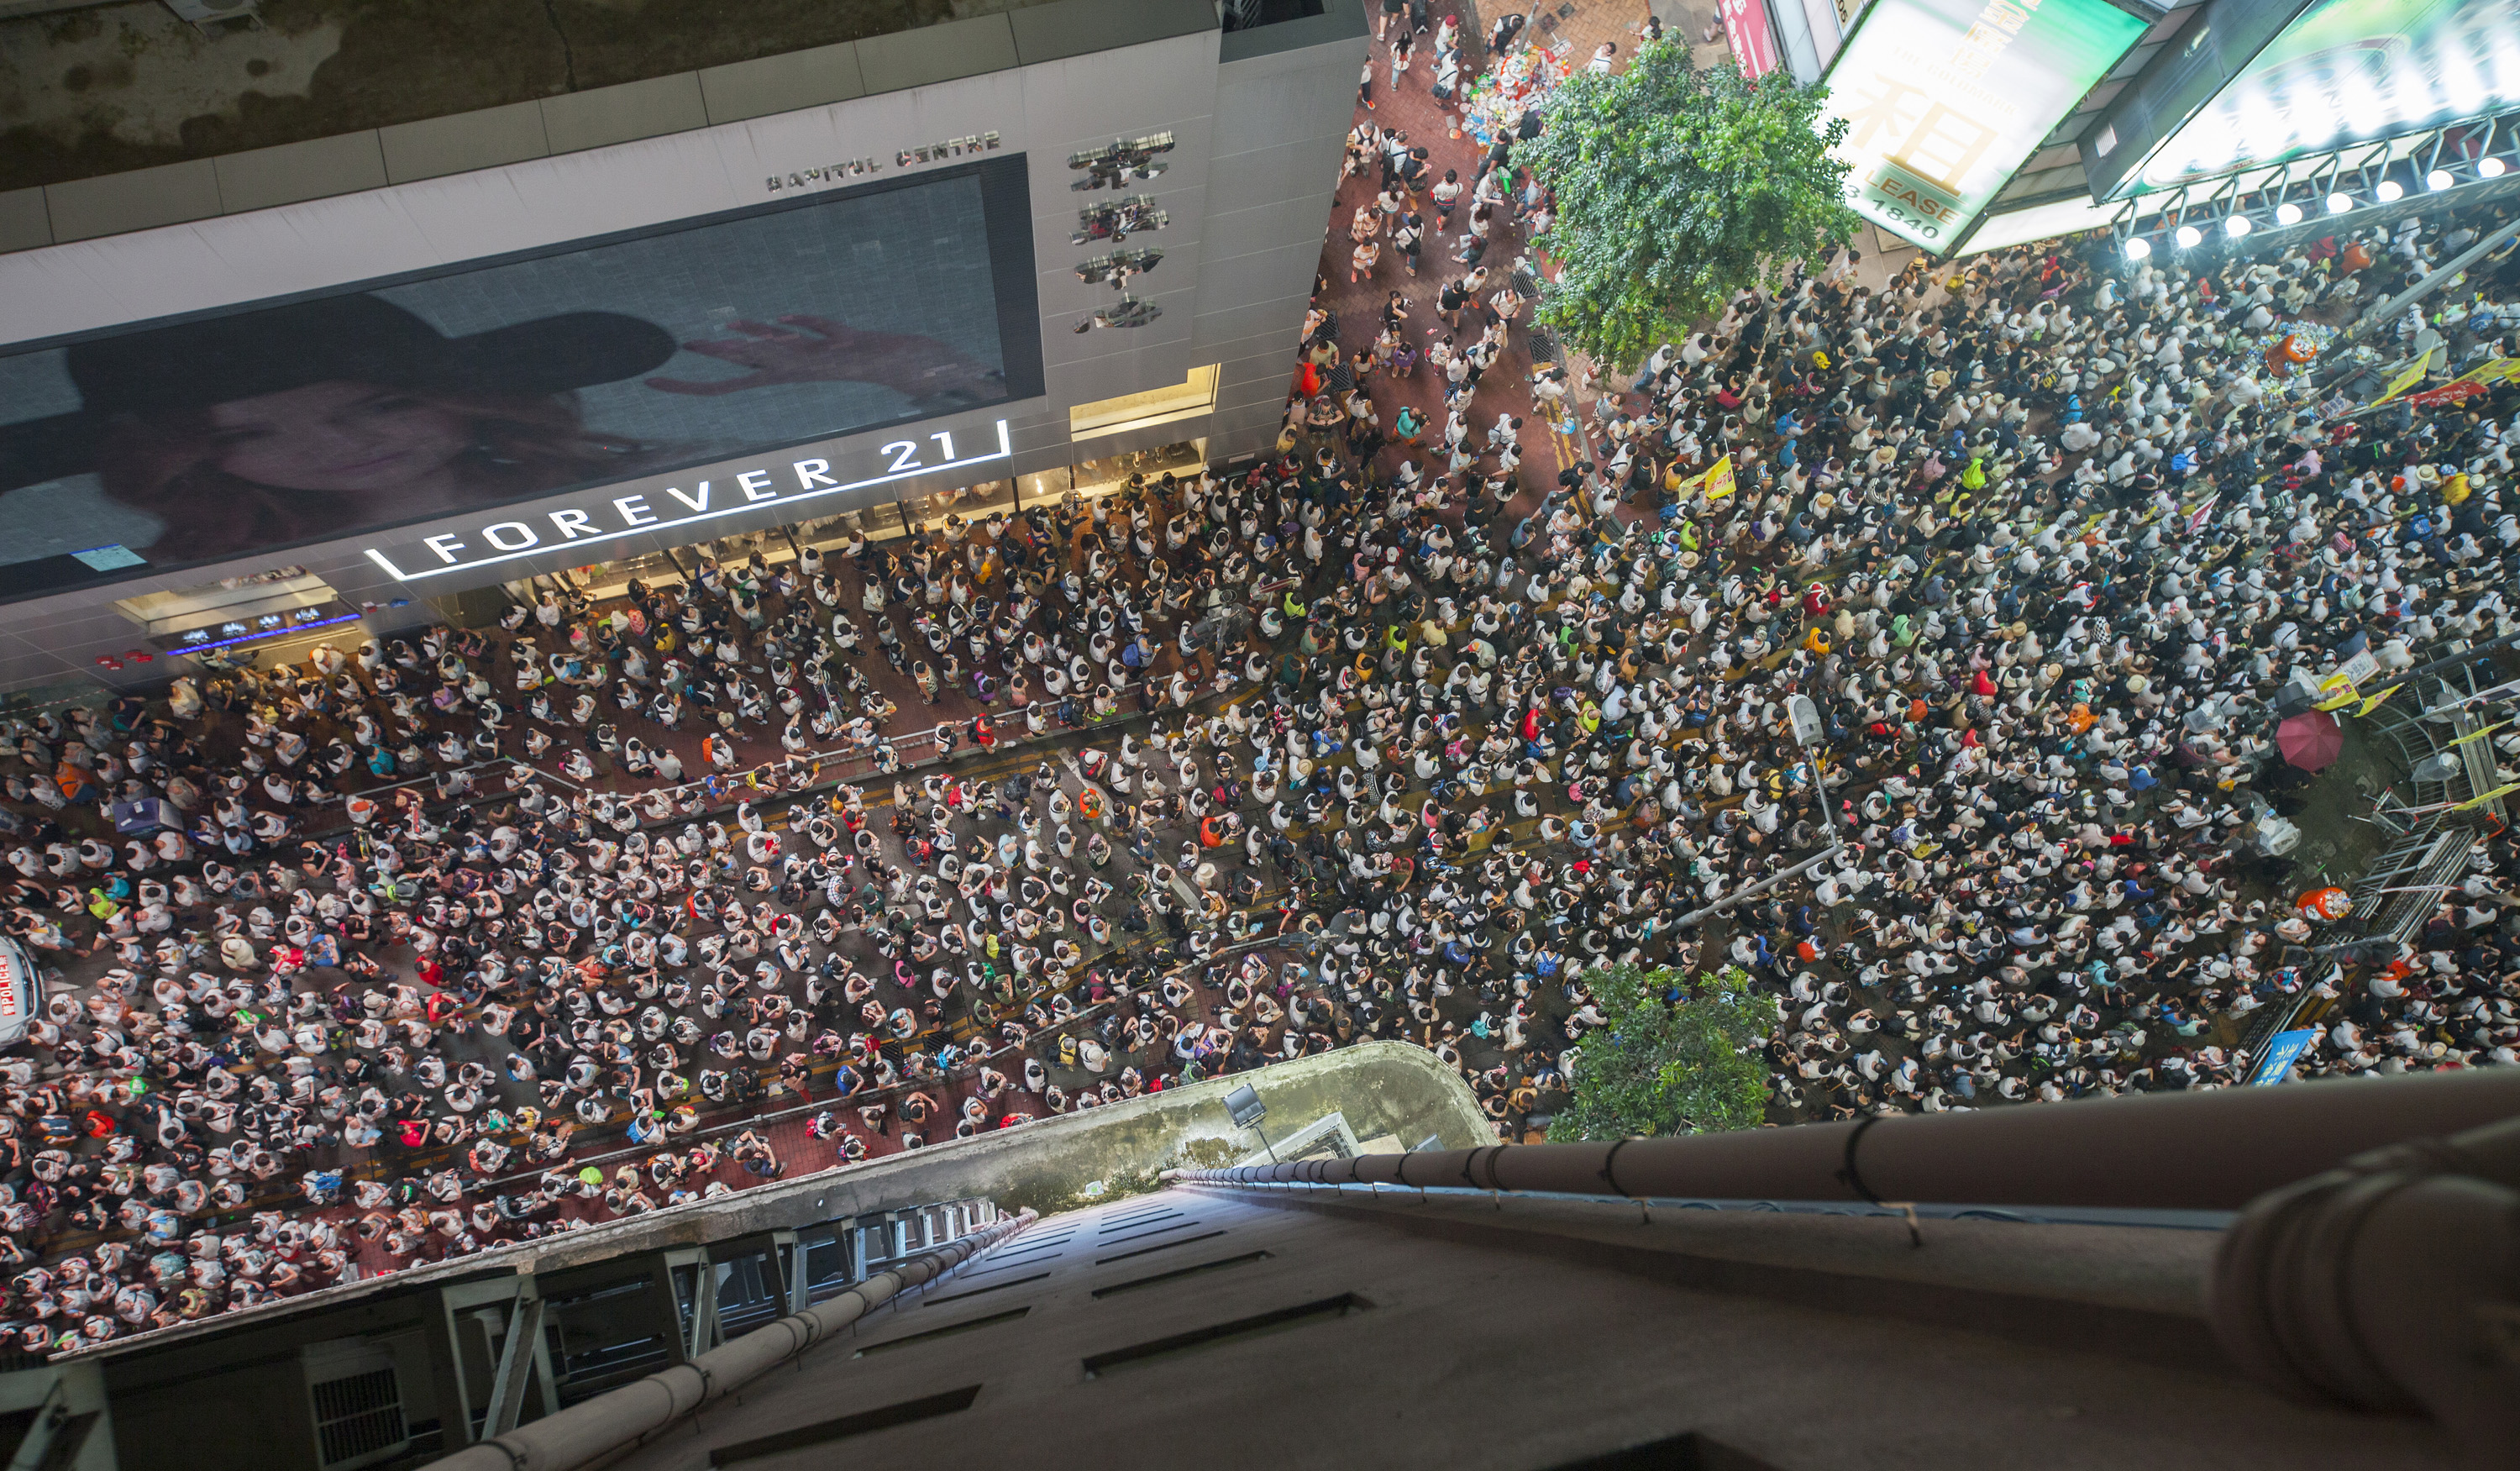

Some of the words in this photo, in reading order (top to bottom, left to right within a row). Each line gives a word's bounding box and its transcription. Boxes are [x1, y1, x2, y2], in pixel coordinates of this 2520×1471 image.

[1949, 0, 2038, 80] 金廣場
[895, 130, 1001, 167] CENTRE
[1840, 72, 2000, 197] 租
[1864, 169, 1962, 227] LEASE
[1872, 199, 1940, 239] 1840
[423, 458, 838, 565] FOREVER
[879, 430, 958, 473] 21
